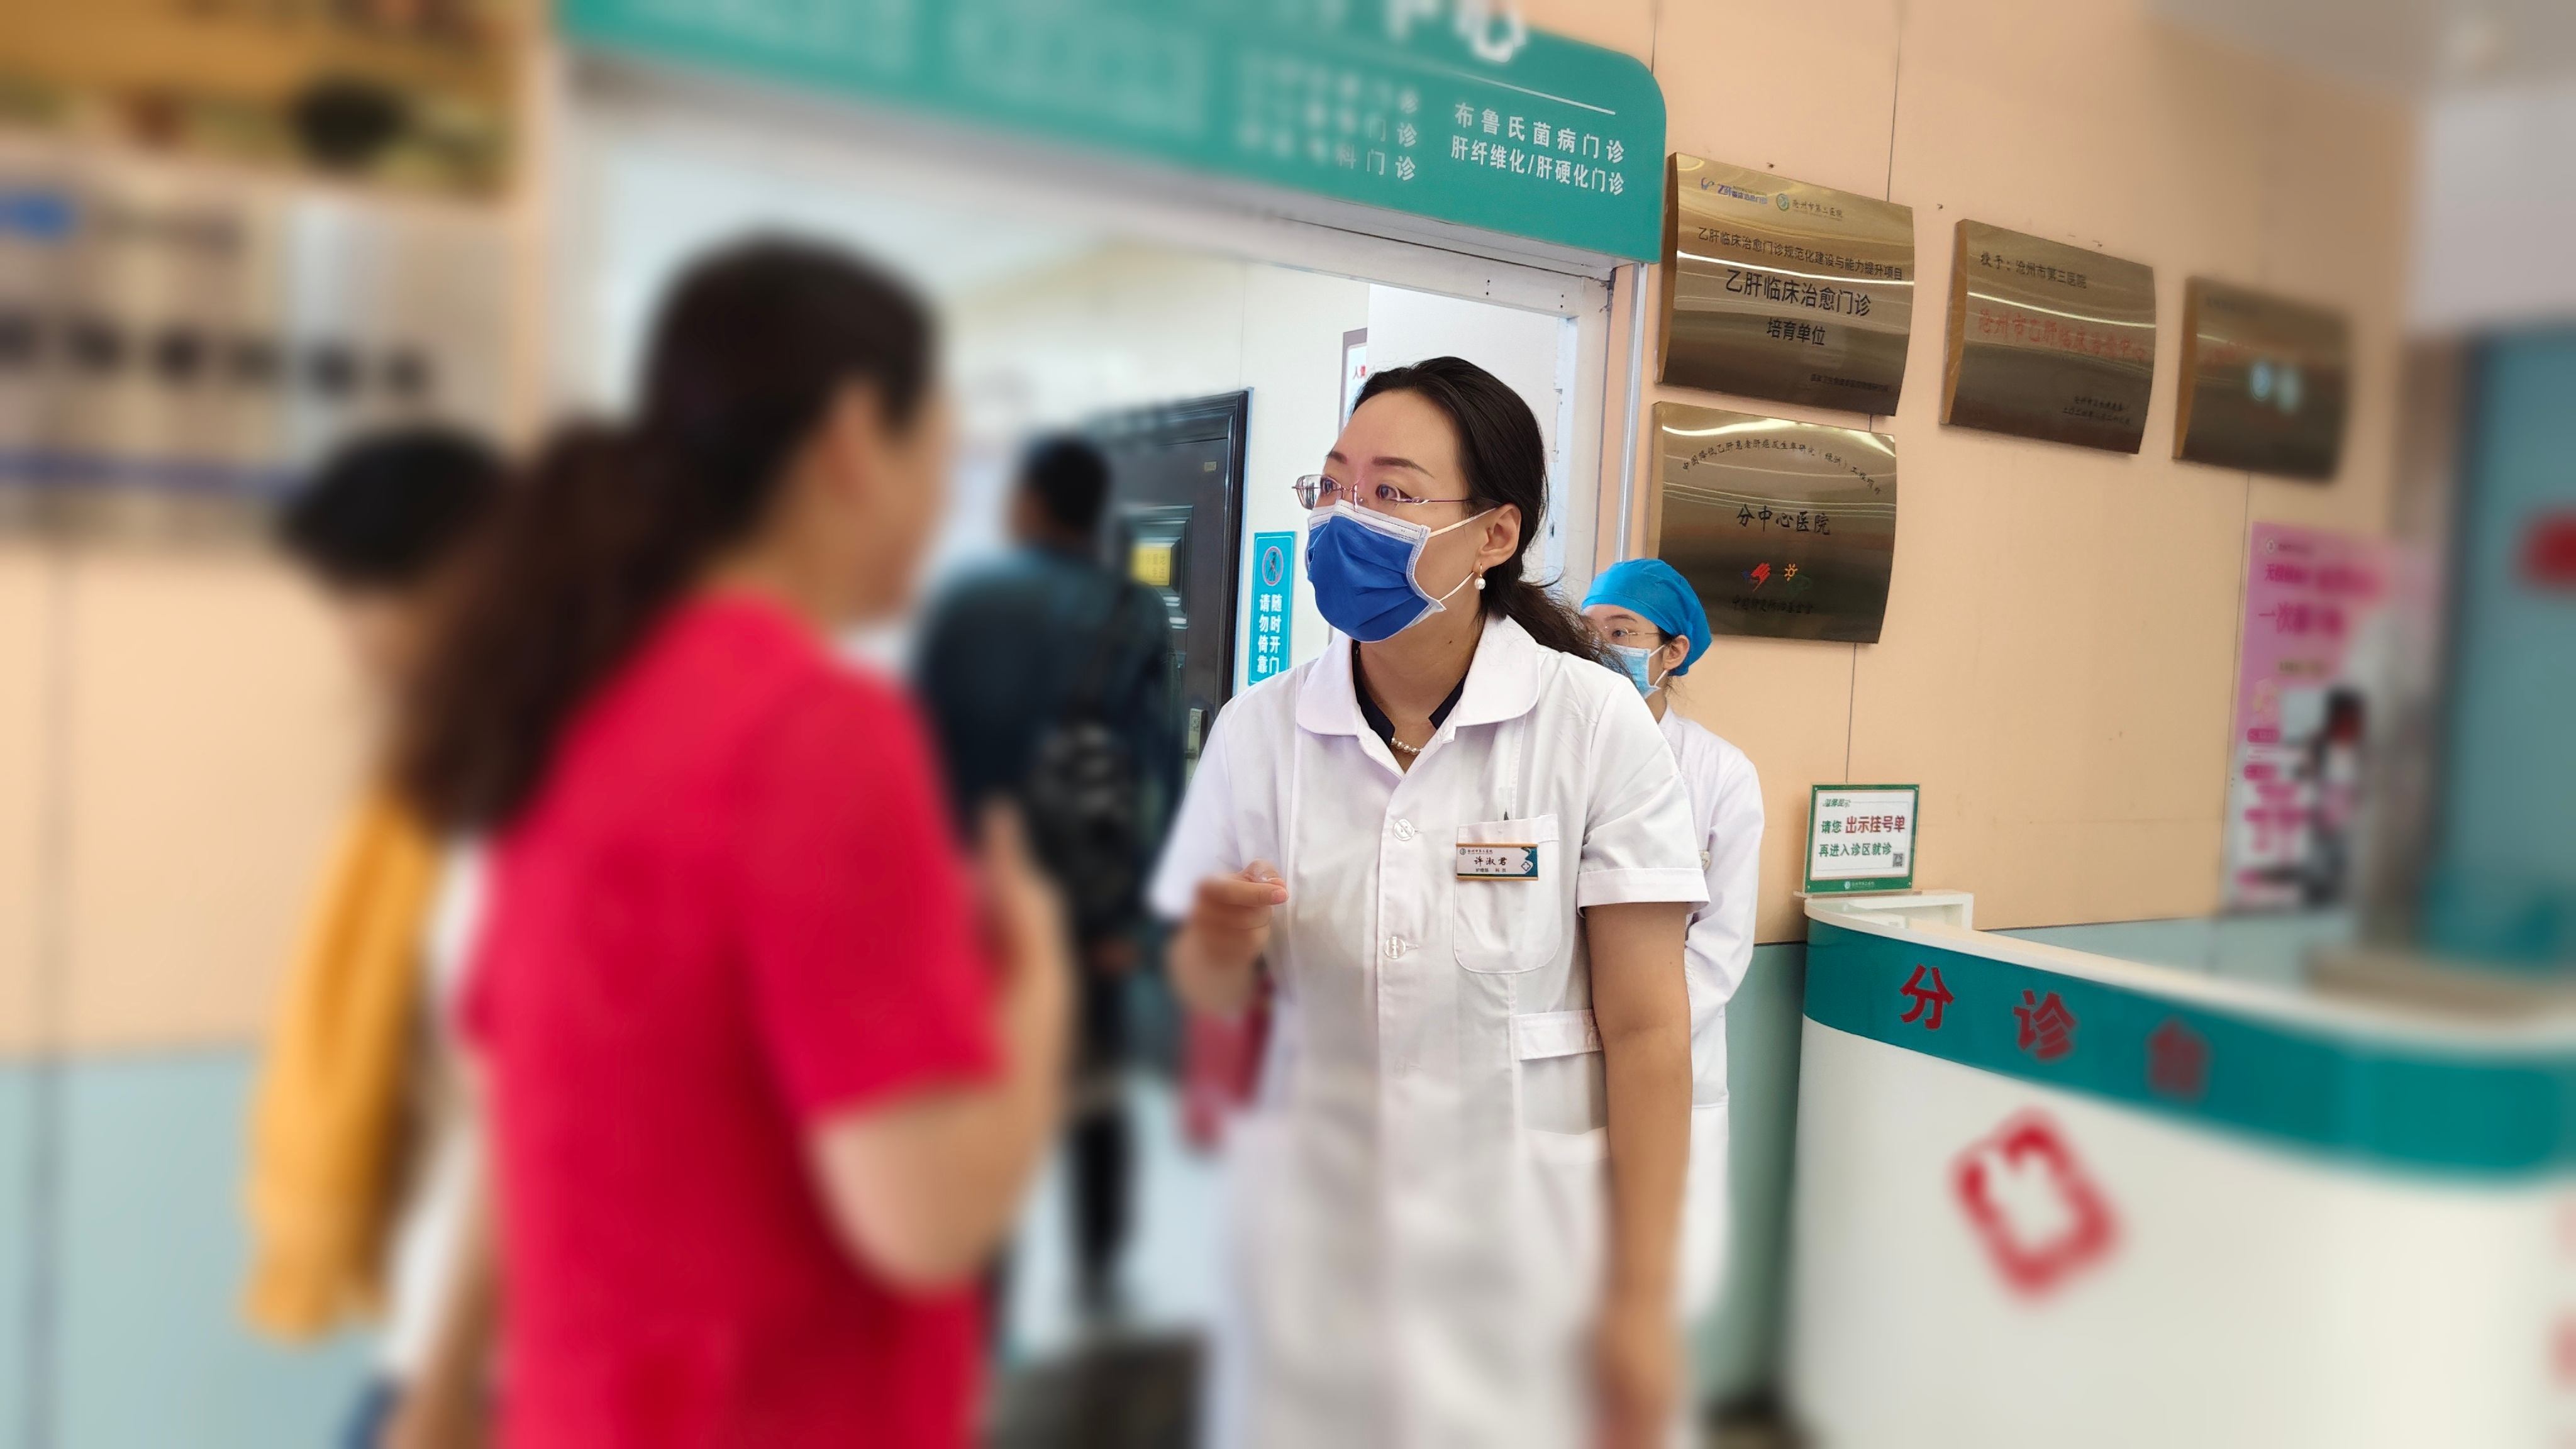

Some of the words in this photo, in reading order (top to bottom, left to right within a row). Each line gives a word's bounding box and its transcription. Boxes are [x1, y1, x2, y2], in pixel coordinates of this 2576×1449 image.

[1455, 102, 1624, 164] 布鲁氏菌病门诊
[1451, 135, 1624, 196] 肝纤维化/肝硬化门诊
[1698, 227, 1902, 280] 乙肝临床治愈门诊规范化建设与能力提升项目
[1725, 269, 1872, 316] 乙肝临床治愈门诊
[1766, 317, 1826, 345] 培育单位
[1736, 504, 1831, 535] 分中心医院
[1257, 594, 1270, 674] 请勿倚靠
[1269, 594, 1282, 674] 随时开门
[1819, 841, 1892, 857] 再进入诊区就诊
[1821, 820, 1841, 834] 请您
[1845, 815, 1905, 833] 出示挂号单
[1899, 963, 2211, 1101] 分诊
